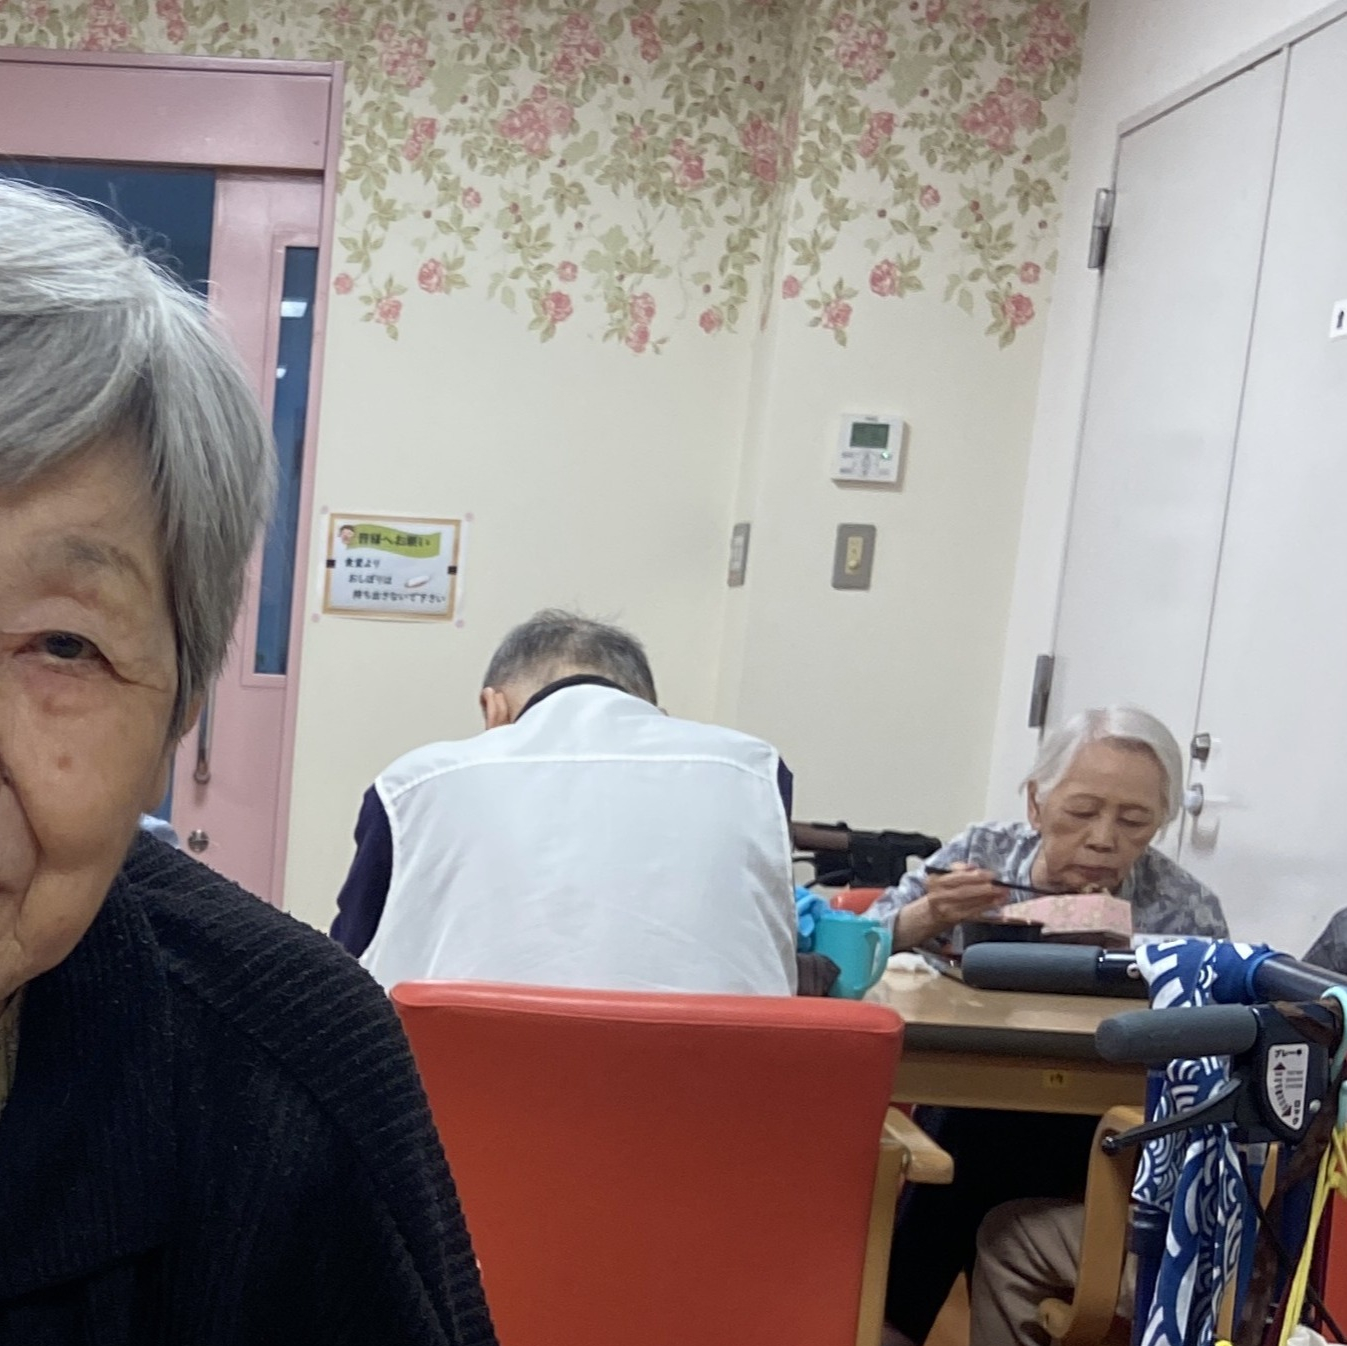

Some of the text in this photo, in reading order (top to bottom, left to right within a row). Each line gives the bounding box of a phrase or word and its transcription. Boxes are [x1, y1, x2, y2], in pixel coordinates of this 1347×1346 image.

[358, 532, 431, 547] 皆様へお願い
[345, 557, 381, 568] 食堂より
[348, 574, 392, 585] おしぼりは
[352, 590, 446, 603] 持ち出さないで下さい
